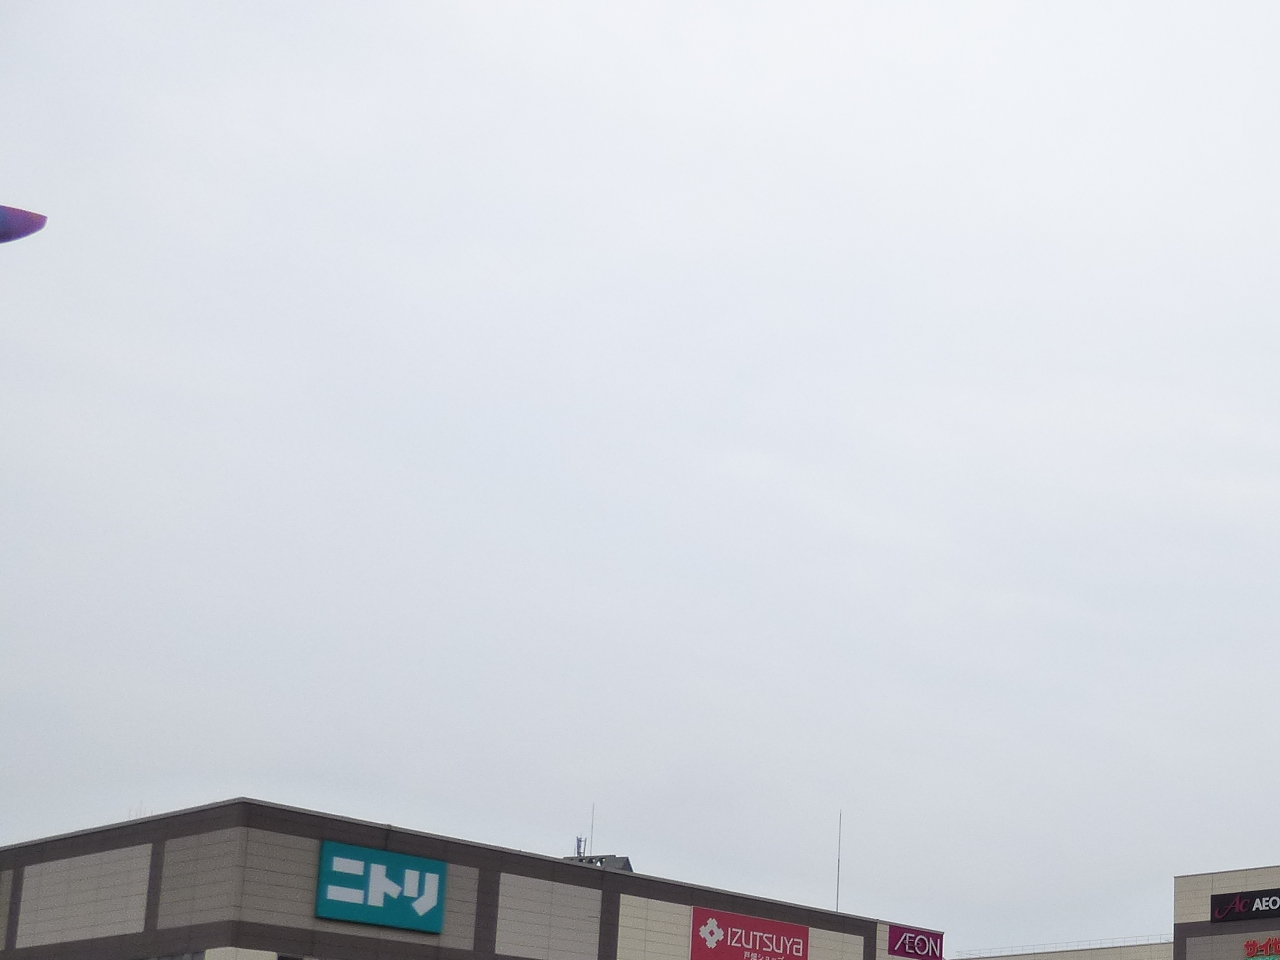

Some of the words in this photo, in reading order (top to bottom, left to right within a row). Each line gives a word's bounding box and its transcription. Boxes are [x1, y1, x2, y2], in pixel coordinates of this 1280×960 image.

[326, 857, 440, 916] ニトリ
[727, 927, 803, 957] IZUTSUYA
